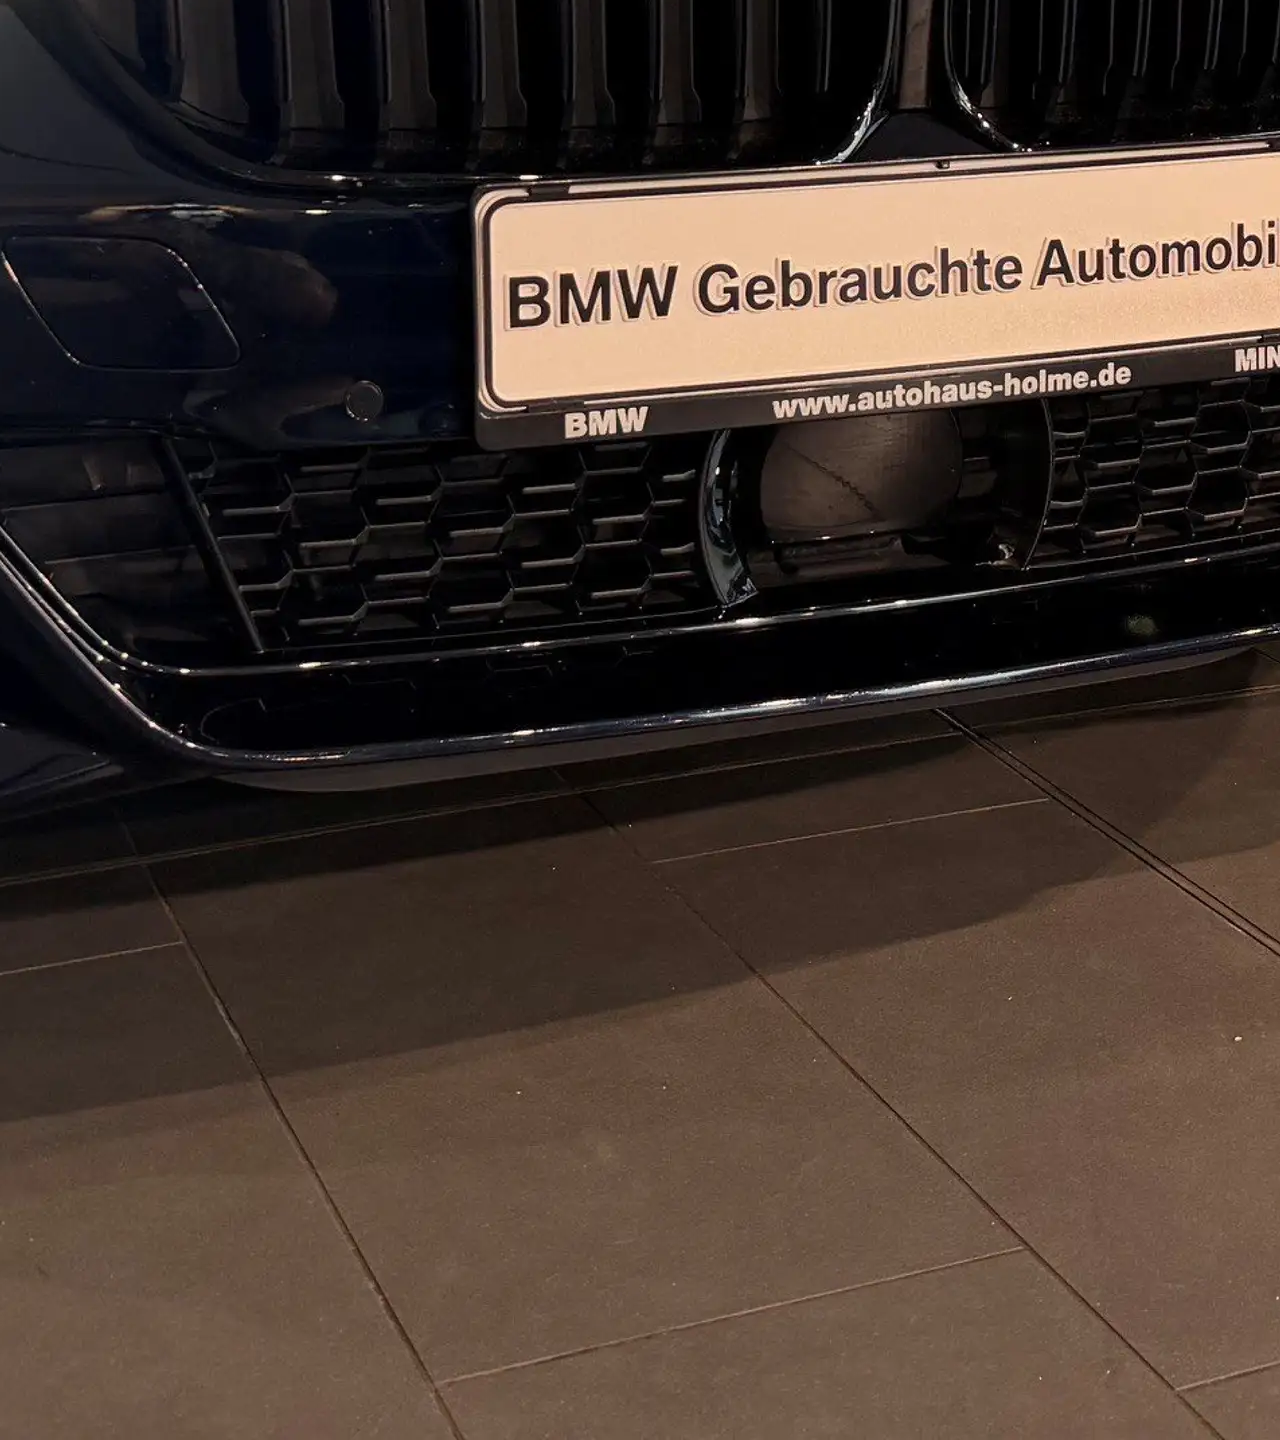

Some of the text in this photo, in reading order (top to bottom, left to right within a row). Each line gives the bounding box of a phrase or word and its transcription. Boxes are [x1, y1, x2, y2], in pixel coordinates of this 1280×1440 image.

[508, 264, 679, 329] BMW
[697, 247, 1024, 314] Gebrauchte
[772, 361, 1133, 419] www.autohaus-holme.de
[564, 406, 649, 439] BMW
